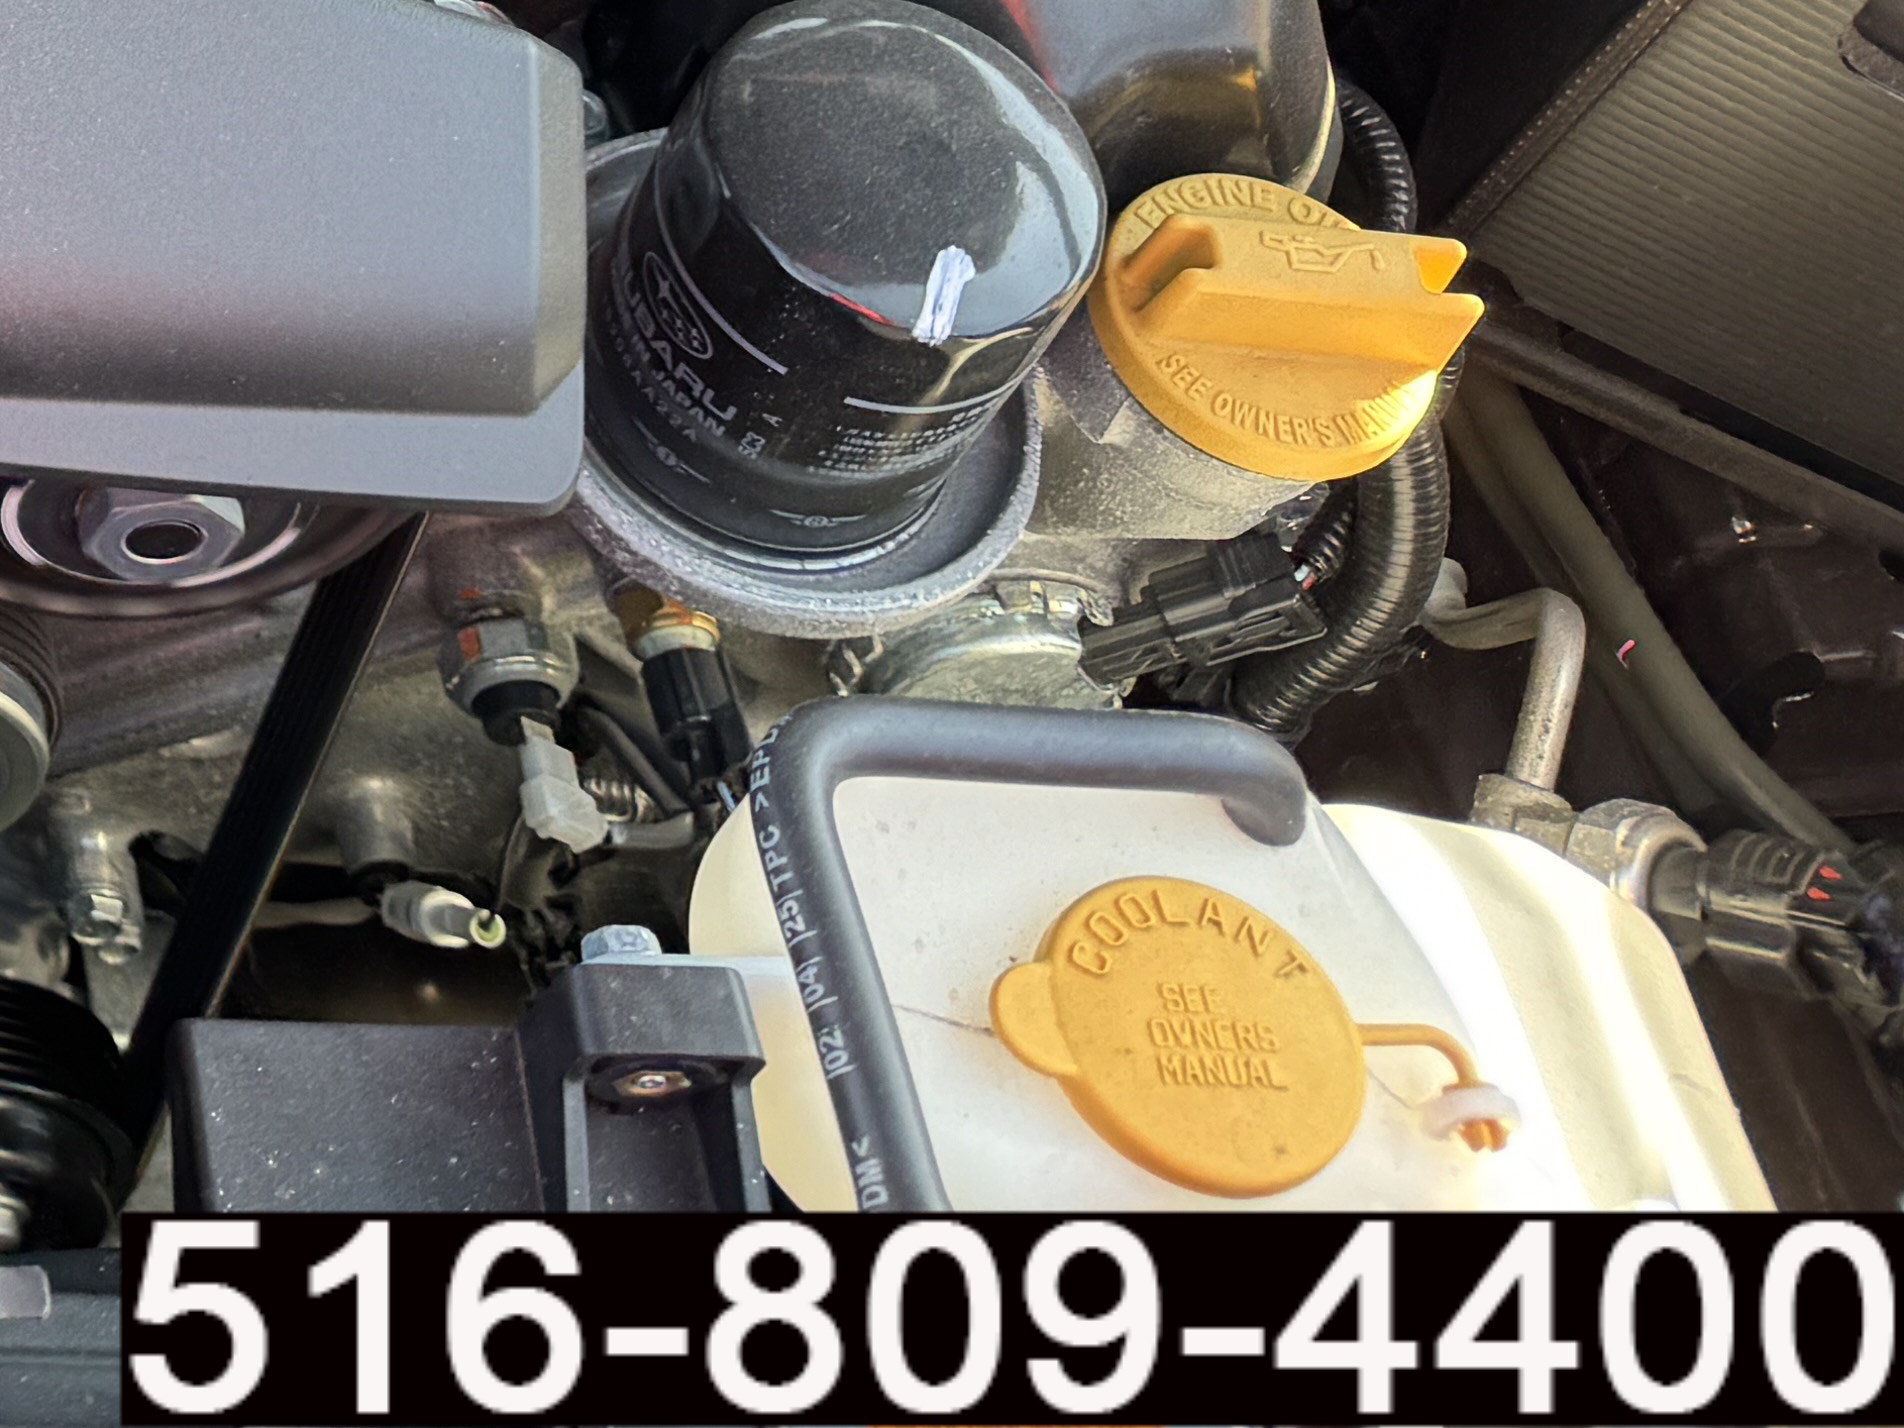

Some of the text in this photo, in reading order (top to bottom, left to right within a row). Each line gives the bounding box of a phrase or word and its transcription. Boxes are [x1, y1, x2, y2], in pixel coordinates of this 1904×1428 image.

[1136, 177, 1276, 228] ENGINE
[1155, 350, 1213, 402] SEE
[1211, 391, 1338, 447] OWNER'S
[759, 824, 794, 892] TPC
[1066, 888, 1310, 975] COOLANT
[1157, 981, 1222, 1014] SEE
[1156, 1053, 1289, 1092] MANUAL
